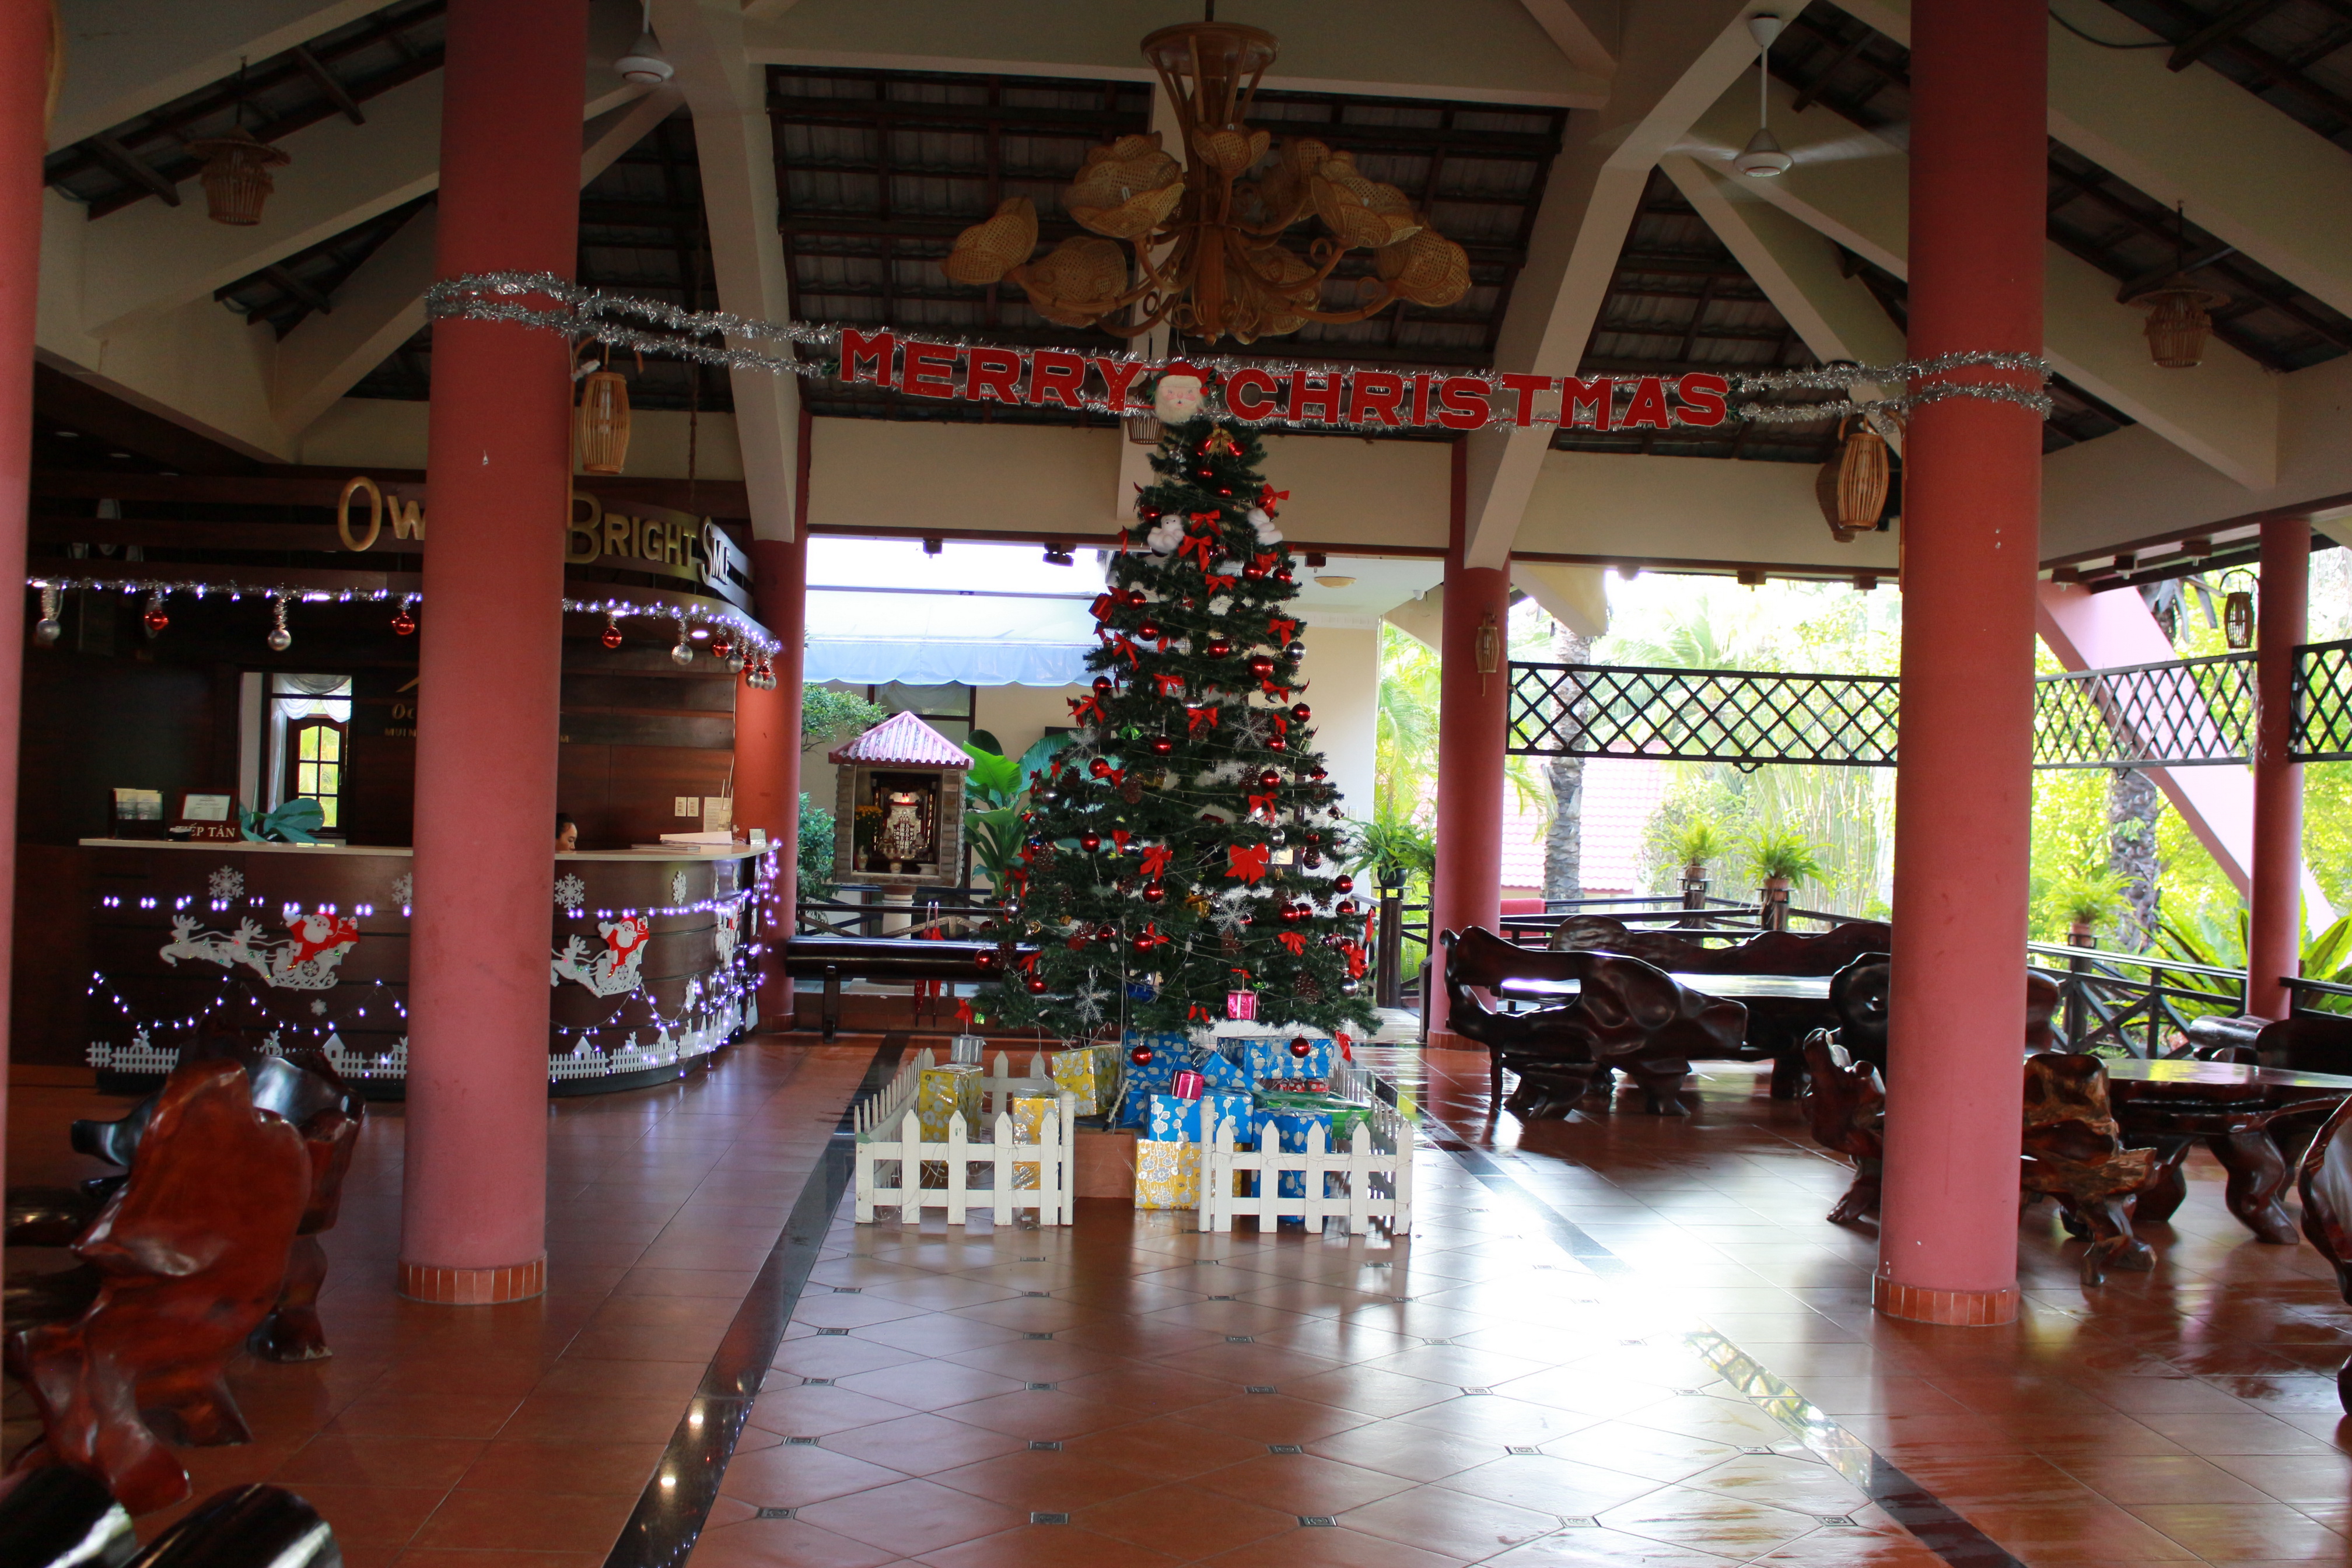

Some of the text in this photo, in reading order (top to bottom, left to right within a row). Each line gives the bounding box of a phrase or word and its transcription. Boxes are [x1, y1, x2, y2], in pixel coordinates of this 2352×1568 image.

[841, 328, 1728, 431] MERRY CHRISTMAS
[565, 490, 697, 567] BRIGHT
